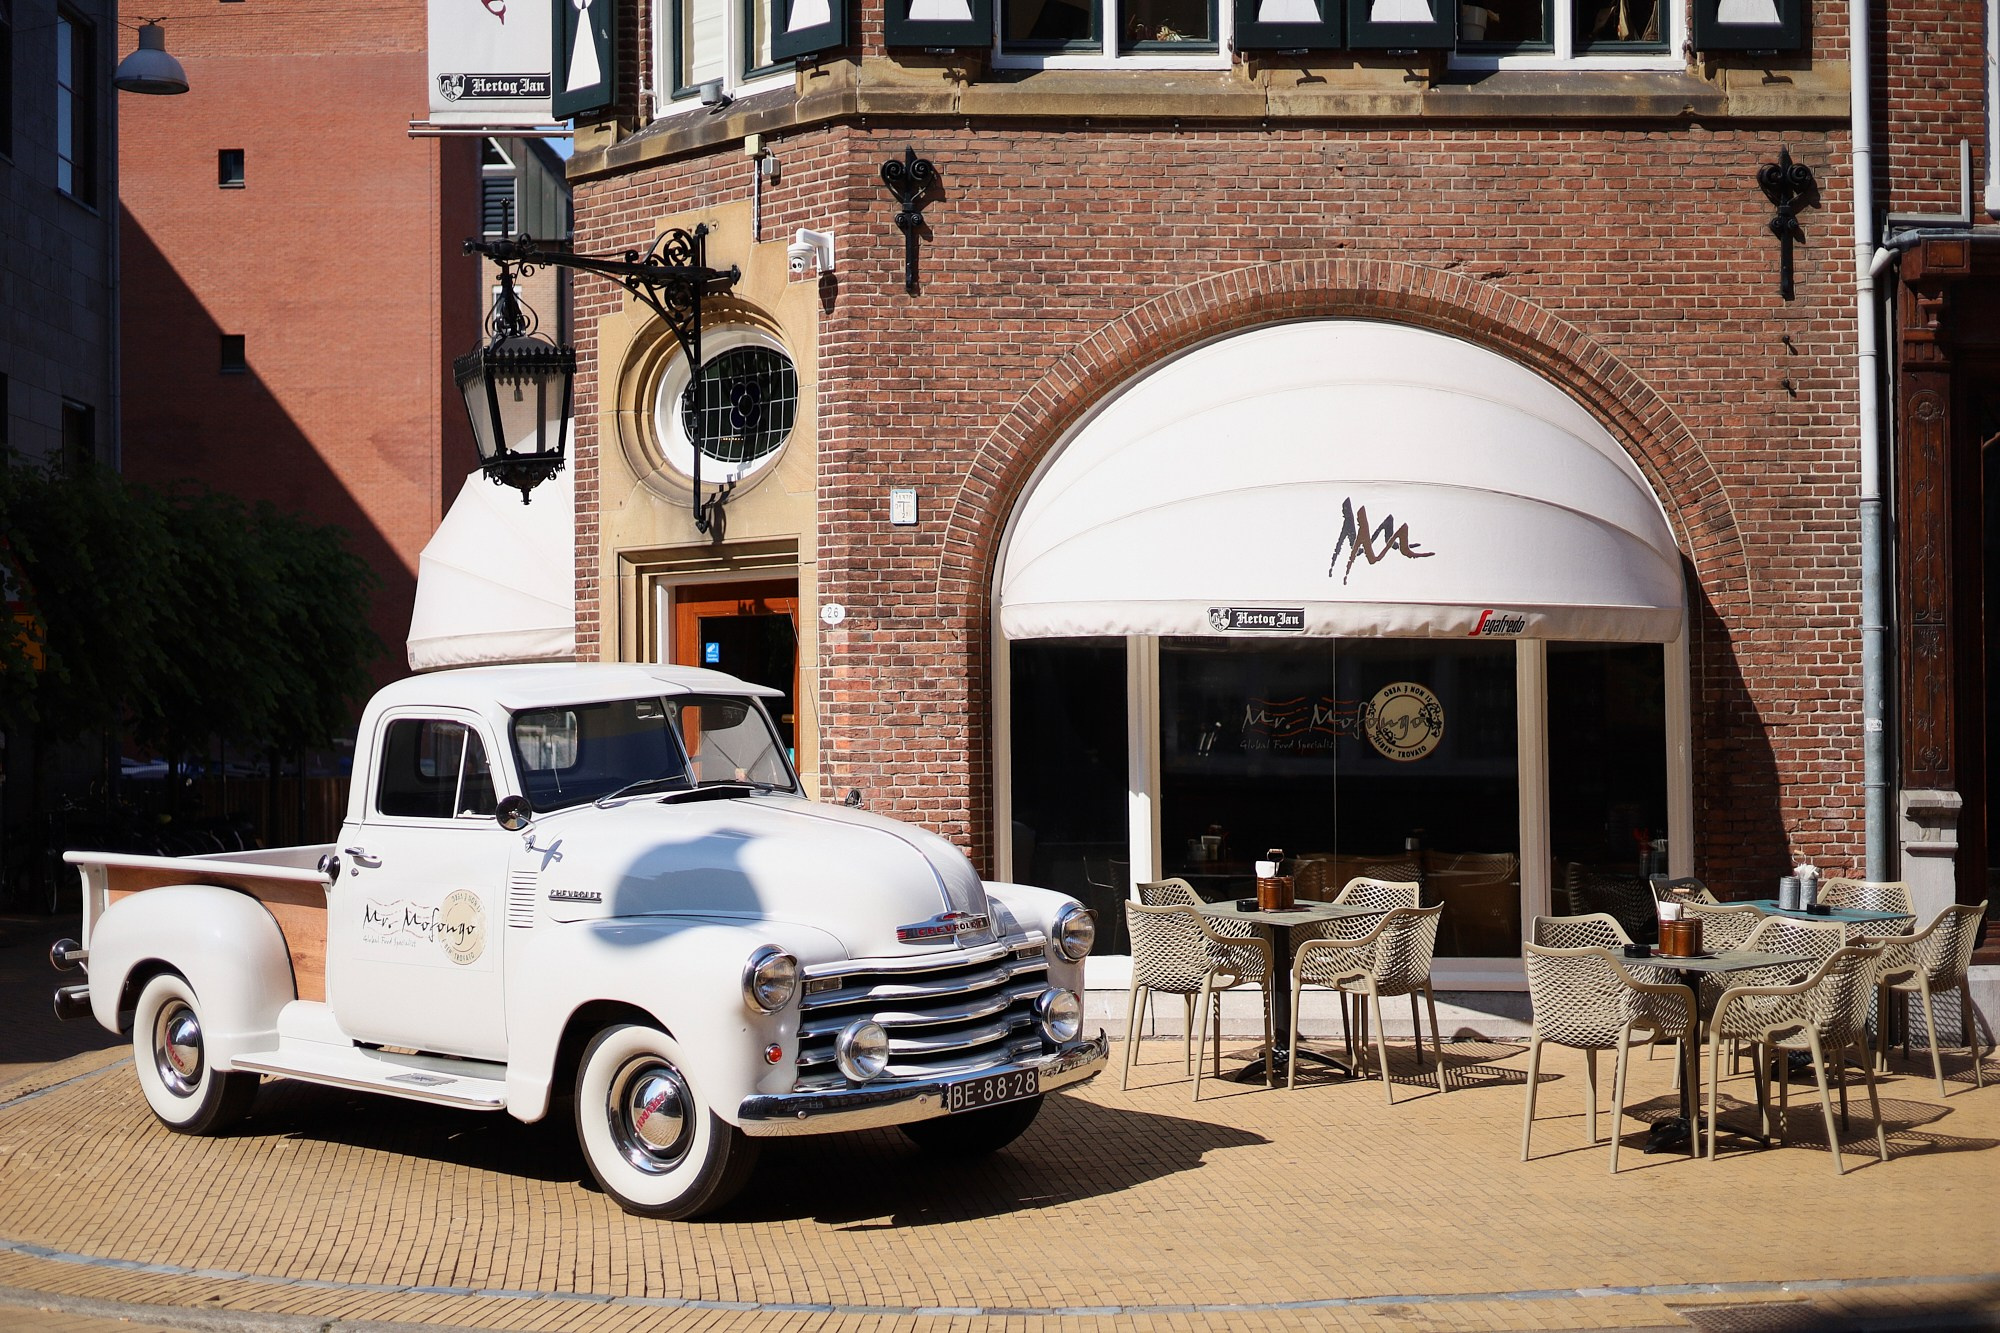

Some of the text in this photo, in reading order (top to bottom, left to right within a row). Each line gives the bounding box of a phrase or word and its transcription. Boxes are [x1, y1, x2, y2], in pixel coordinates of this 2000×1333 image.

[471, 78, 545, 95] Hertog Jan
[827, 607, 839, 618] 26
[1236, 611, 1300, 627] Hertog Jan
[1468, 609, 1526, 636] Segafredo
[1383, 686, 1401, 697] VERO
[1410, 686, 1425, 697] NON
[1242, 701, 1429, 741] Mr. Mofongo
[1273, 739, 1294, 750] Food
[1297, 738, 1337, 753] Specialis
[1397, 745, 1427, 758] TROVATO
[362, 903, 476, 945] Mr. Mofongo
[918, 919, 984, 936] CHEVROLET
